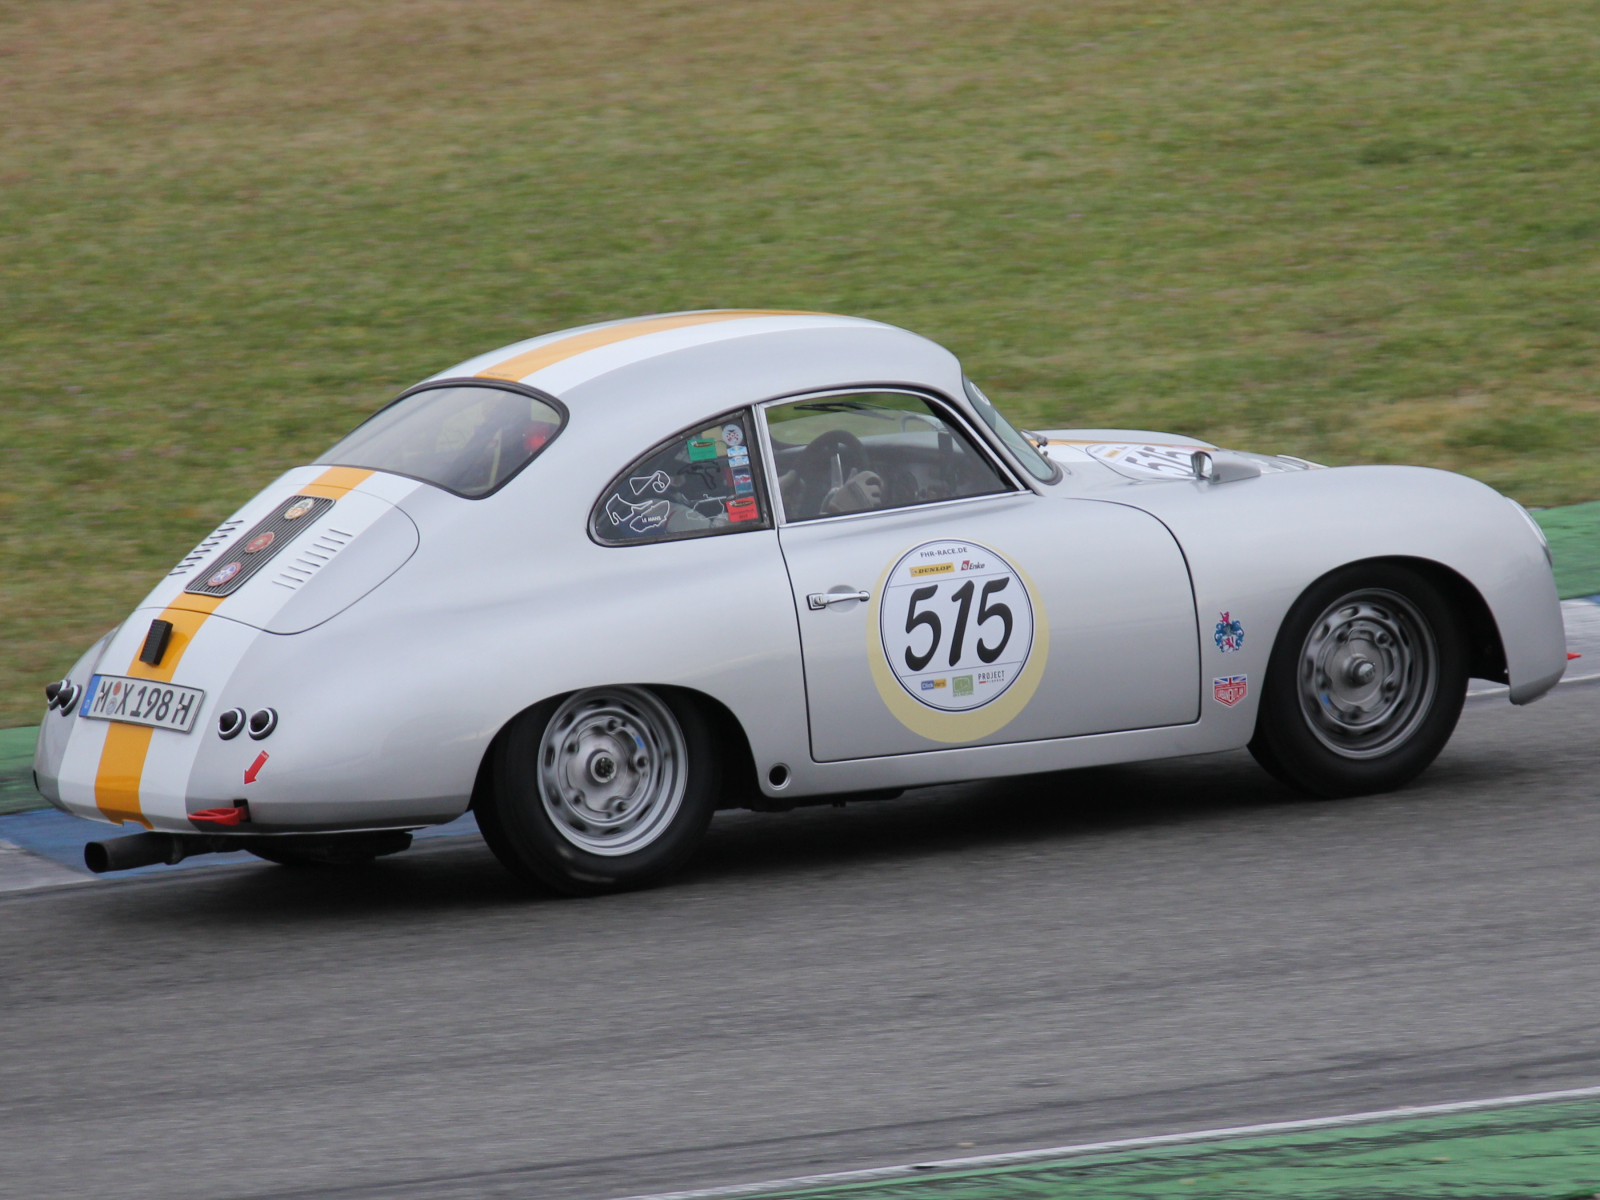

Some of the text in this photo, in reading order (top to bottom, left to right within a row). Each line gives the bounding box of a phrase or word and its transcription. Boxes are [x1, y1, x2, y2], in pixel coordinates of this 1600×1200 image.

[920, 547, 968, 557] FHR-RACE.DE
[918, 565, 952, 574] DUNLOP
[905, 577, 1013, 671] 515
[978, 669, 1005, 680] PROJECT
[93, 681, 113, 712] M
[114, 683, 135, 715] X
